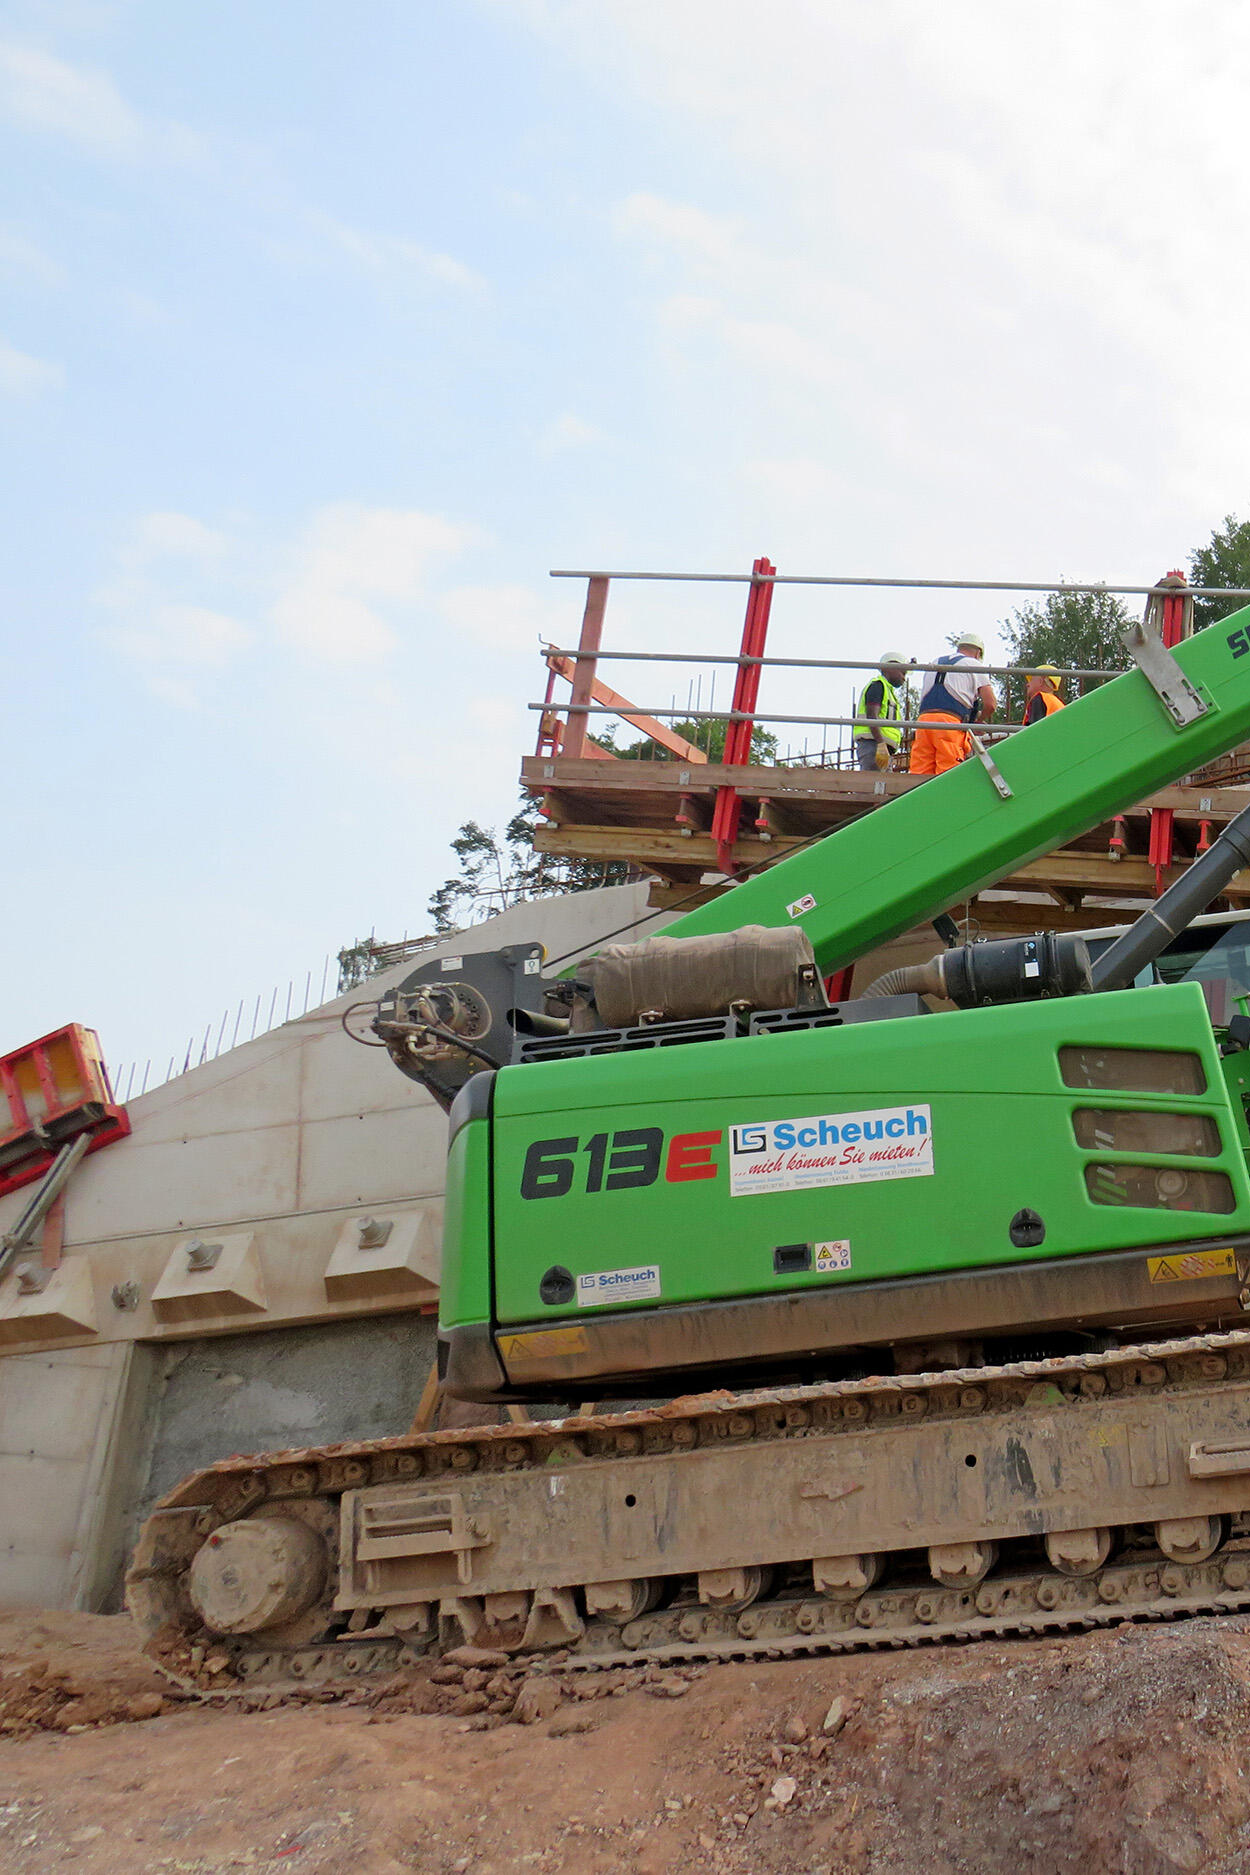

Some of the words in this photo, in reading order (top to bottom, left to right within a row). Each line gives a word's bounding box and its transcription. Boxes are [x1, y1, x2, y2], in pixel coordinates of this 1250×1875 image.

[773, 1110, 927, 1150] Scheuch
[520, 1127, 722, 1200] 613E
[785, 1153, 836, 1171] können
[838, 1145, 866, 1166] Sie
[598, 1269, 656, 1286] Scheuch
